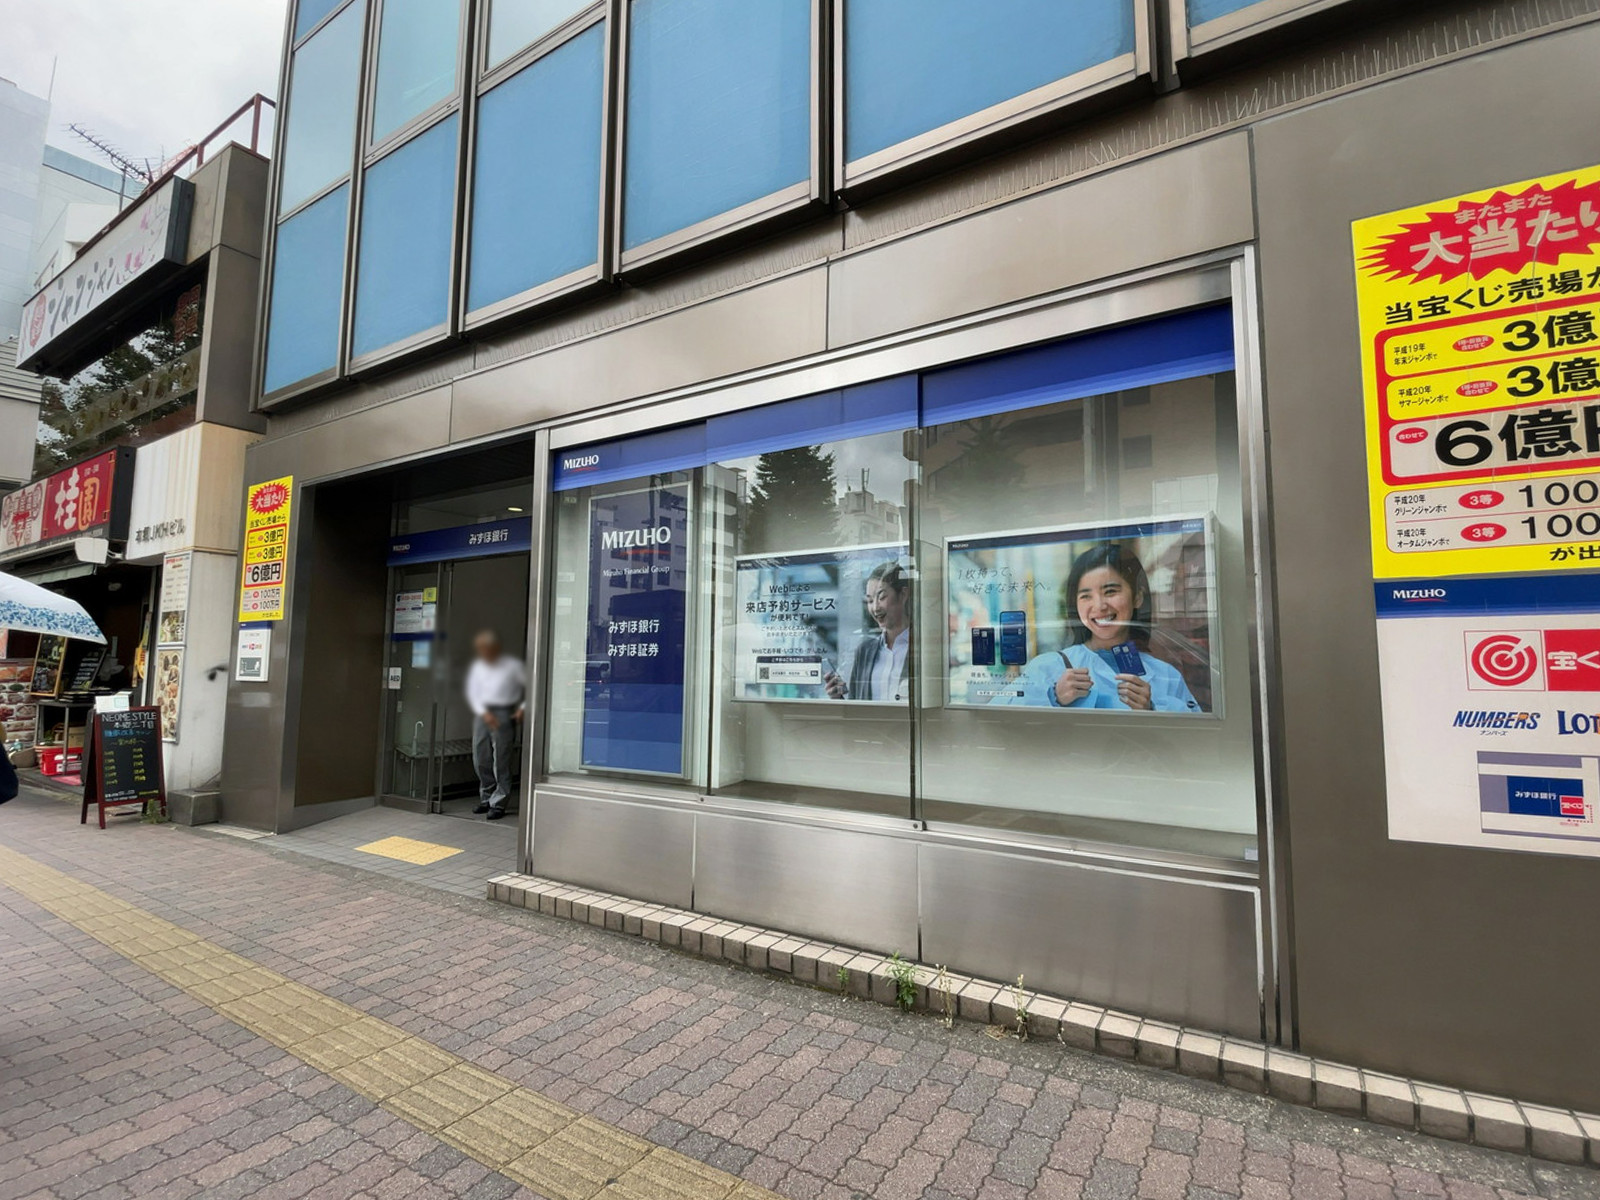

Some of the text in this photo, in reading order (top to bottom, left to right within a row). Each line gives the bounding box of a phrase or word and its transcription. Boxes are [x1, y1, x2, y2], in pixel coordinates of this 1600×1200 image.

[1454, 193, 1553, 225] またまた
[1394, 343, 1426, 355] 平成19年
[1461, 342, 1486, 351] 合わせて
[1394, 353, 1438, 366] 年末ジャンボで
[1506, 356, 1600, 398] 3億
[1398, 385, 1431, 398] 平成20年
[1465, 388, 1489, 396] 合わせて
[1399, 395, 1449, 408] サマージャンボで
[1398, 431, 1425, 440] 合わせて
[564, 454, 599, 470] MIZUHO
[256, 489, 285, 509] 大当たり
[1394, 494, 1426, 505] 平成20年
[1469, 493, 1493, 506] 3等
[1519, 479, 1599, 508] 100
[1394, 504, 1447, 516] グリーンジャンボで
[1521, 511, 1600, 540] 100
[264, 528, 284, 543] 3億円
[469, 528, 509, 545] みずほ銀行
[602, 526, 672, 550] MIZUHO
[1397, 528, 1426, 537] 平成20年
[1471, 526, 1496, 539] 3等
[1397, 537, 1450, 548] オータムジャンボで
[263, 545, 282, 560] 3億円
[251, 562, 281, 583] 6億円
[602, 564, 670, 578] Mizuho Financial Group
[769, 584, 811, 594] Webによる
[972, 581, 1051, 595] 好きな未来へ。
[1393, 588, 1446, 599] MIZUHO
[745, 598, 836, 613] 来店予約サービス
[608, 619, 660, 634] みずほ銀行
[607, 643, 659, 658] みずほ証券
[390, 674, 401, 682] AED
[132, 712, 157, 721] STYLE
[1453, 710, 1541, 730] NUMBERS
[1514, 790, 1557, 800] みずほ銀行
